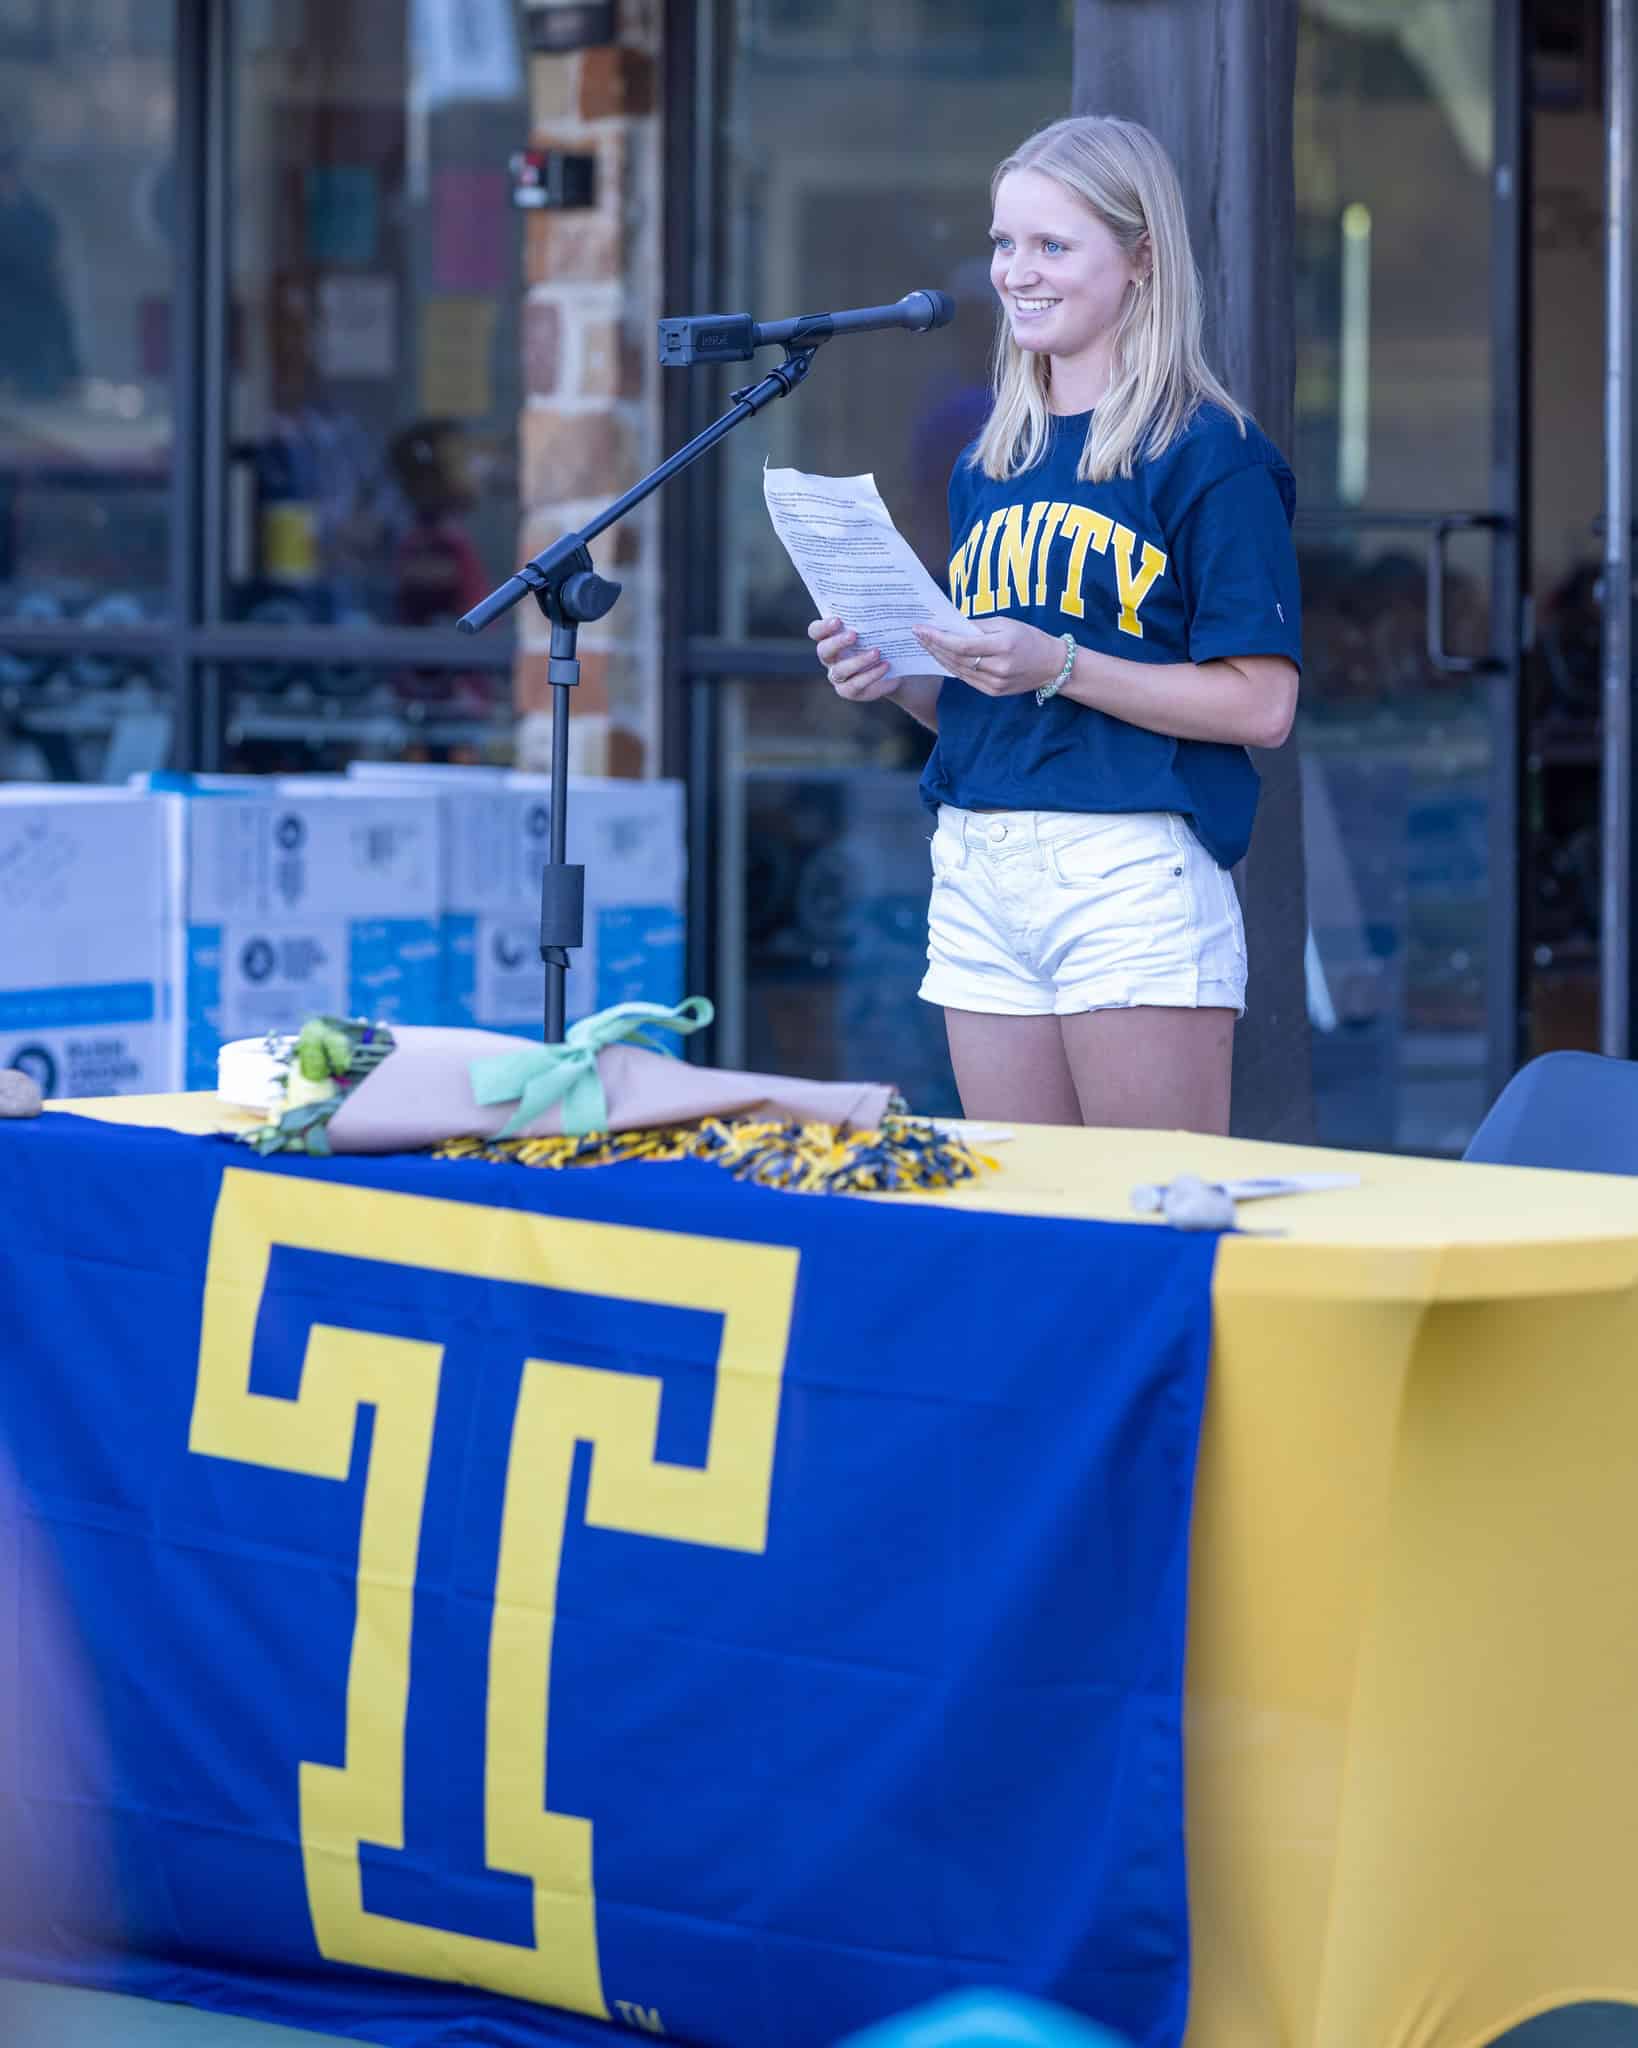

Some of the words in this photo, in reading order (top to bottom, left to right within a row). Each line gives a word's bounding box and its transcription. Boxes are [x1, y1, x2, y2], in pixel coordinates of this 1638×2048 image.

[949, 501, 1168, 639] RINITY
[188, 1166, 800, 2021] T
[615, 1999, 666, 2033] TM
